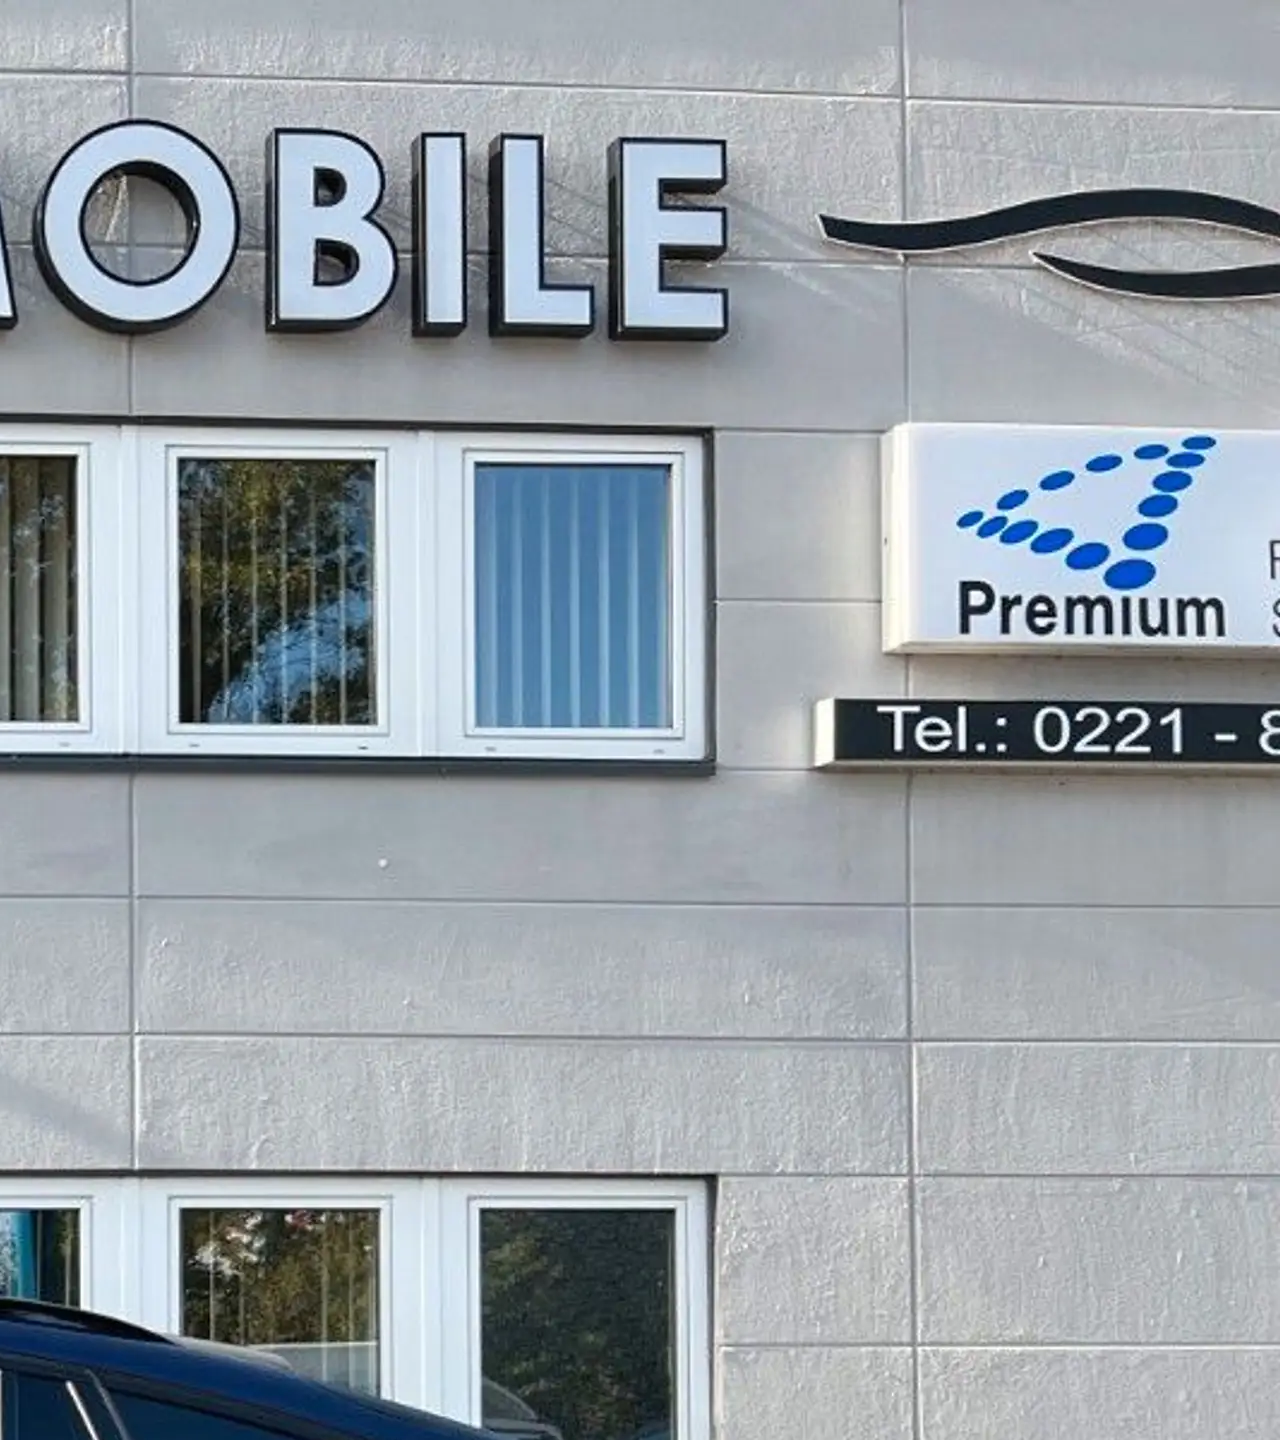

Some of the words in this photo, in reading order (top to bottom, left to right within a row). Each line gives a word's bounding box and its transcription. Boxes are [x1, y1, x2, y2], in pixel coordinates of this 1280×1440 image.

[959, 580, 1225, 637] Premium
[877, 705, 1007, 753] Tel.:
[1033, 706, 1183, 754] 0221
